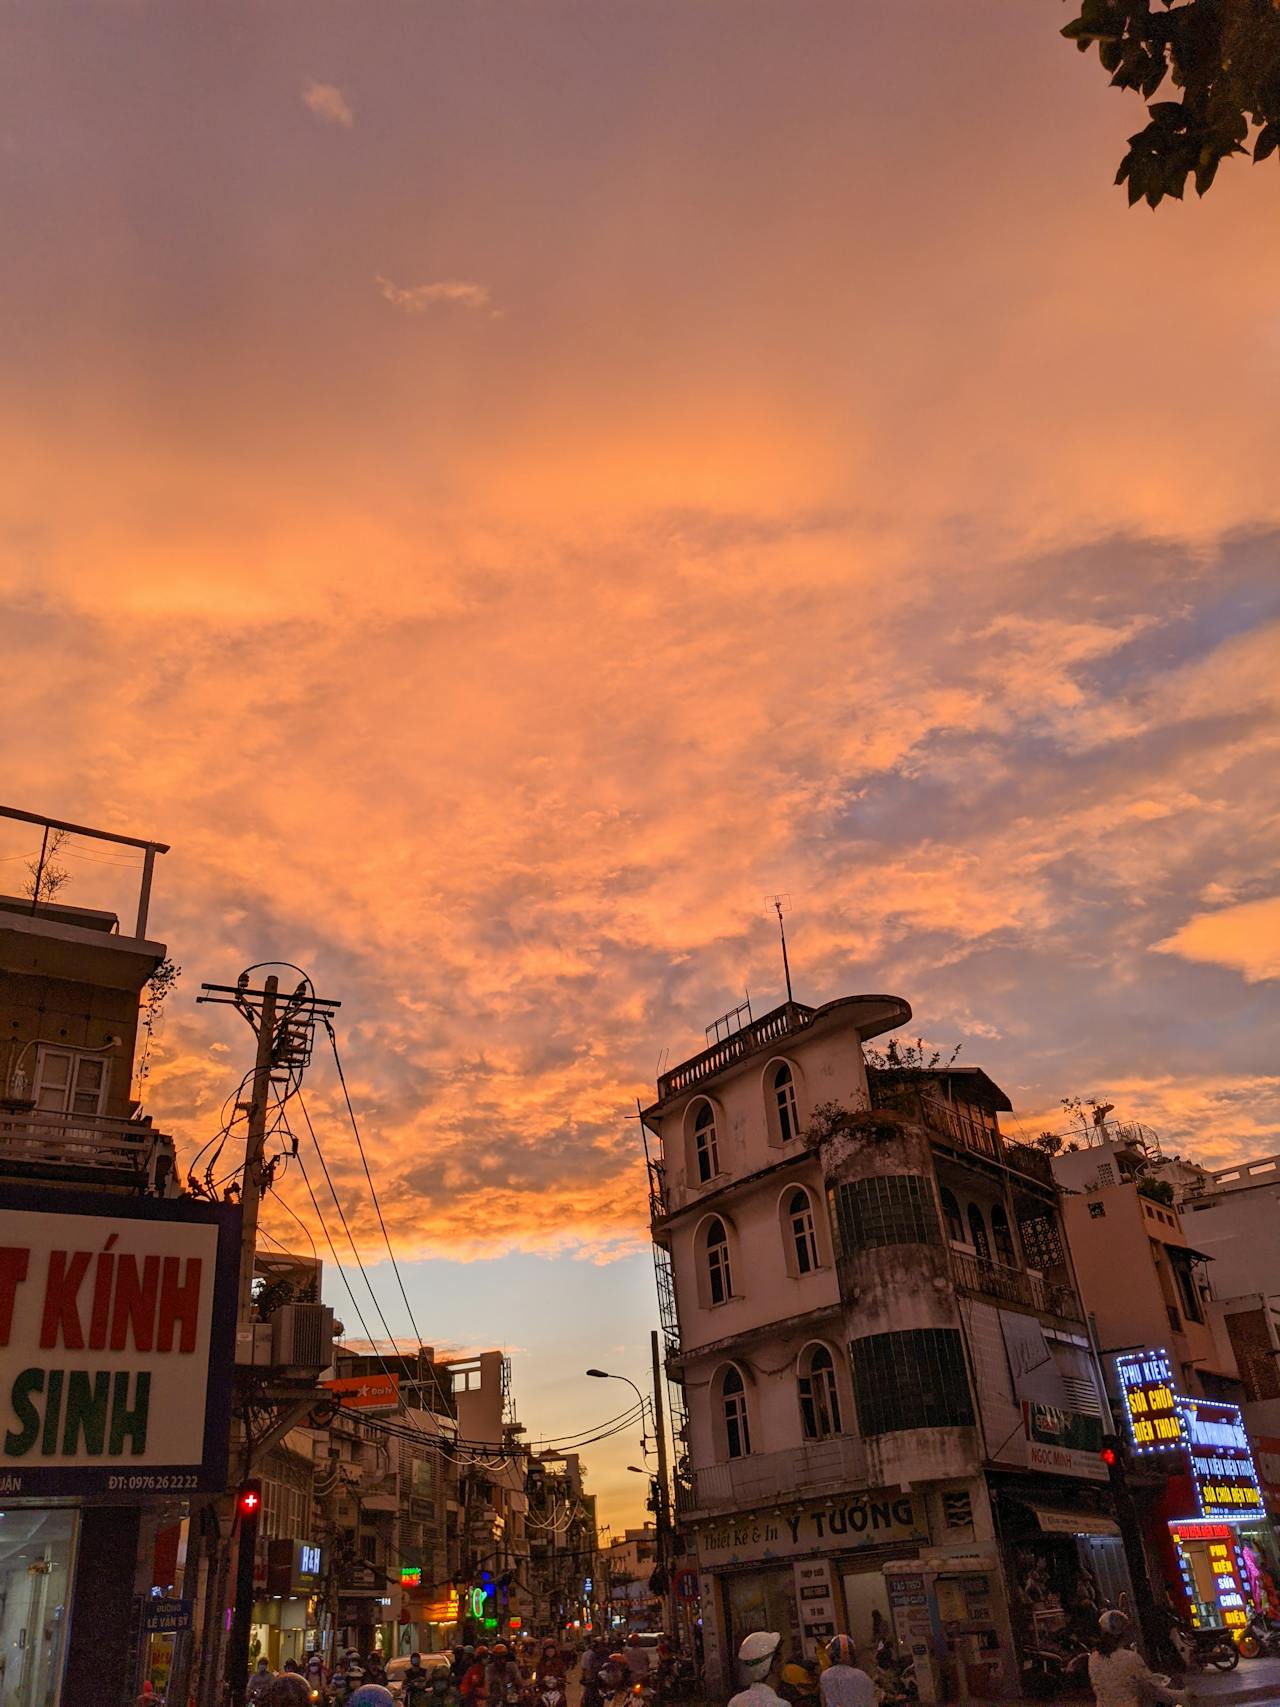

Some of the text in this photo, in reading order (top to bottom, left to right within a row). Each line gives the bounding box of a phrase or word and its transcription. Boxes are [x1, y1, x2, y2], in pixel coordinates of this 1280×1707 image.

[39, 1233, 203, 1355] KÍNH
[1122, 1355, 1168, 1387] PHỤ KIỆN
[1129, 1385, 1174, 1413] SỬA CHỮA
[4, 1367, 152, 1457] SINH
[1154, 1417, 1181, 1441] THOẠI
[1053, 1451, 1072, 1469] MINH
[752, 1527, 761, 1543] &
[765, 1525, 778, 1542] In
[810, 1497, 914, 1538] TƯỞNG
[1209, 1545, 1227, 1557] PHỤ
[1212, 1560, 1233, 1575] KIỆN
[1218, 1575, 1236, 1589] SỬA
[1220, 1592, 1243, 1606] CHỮA
